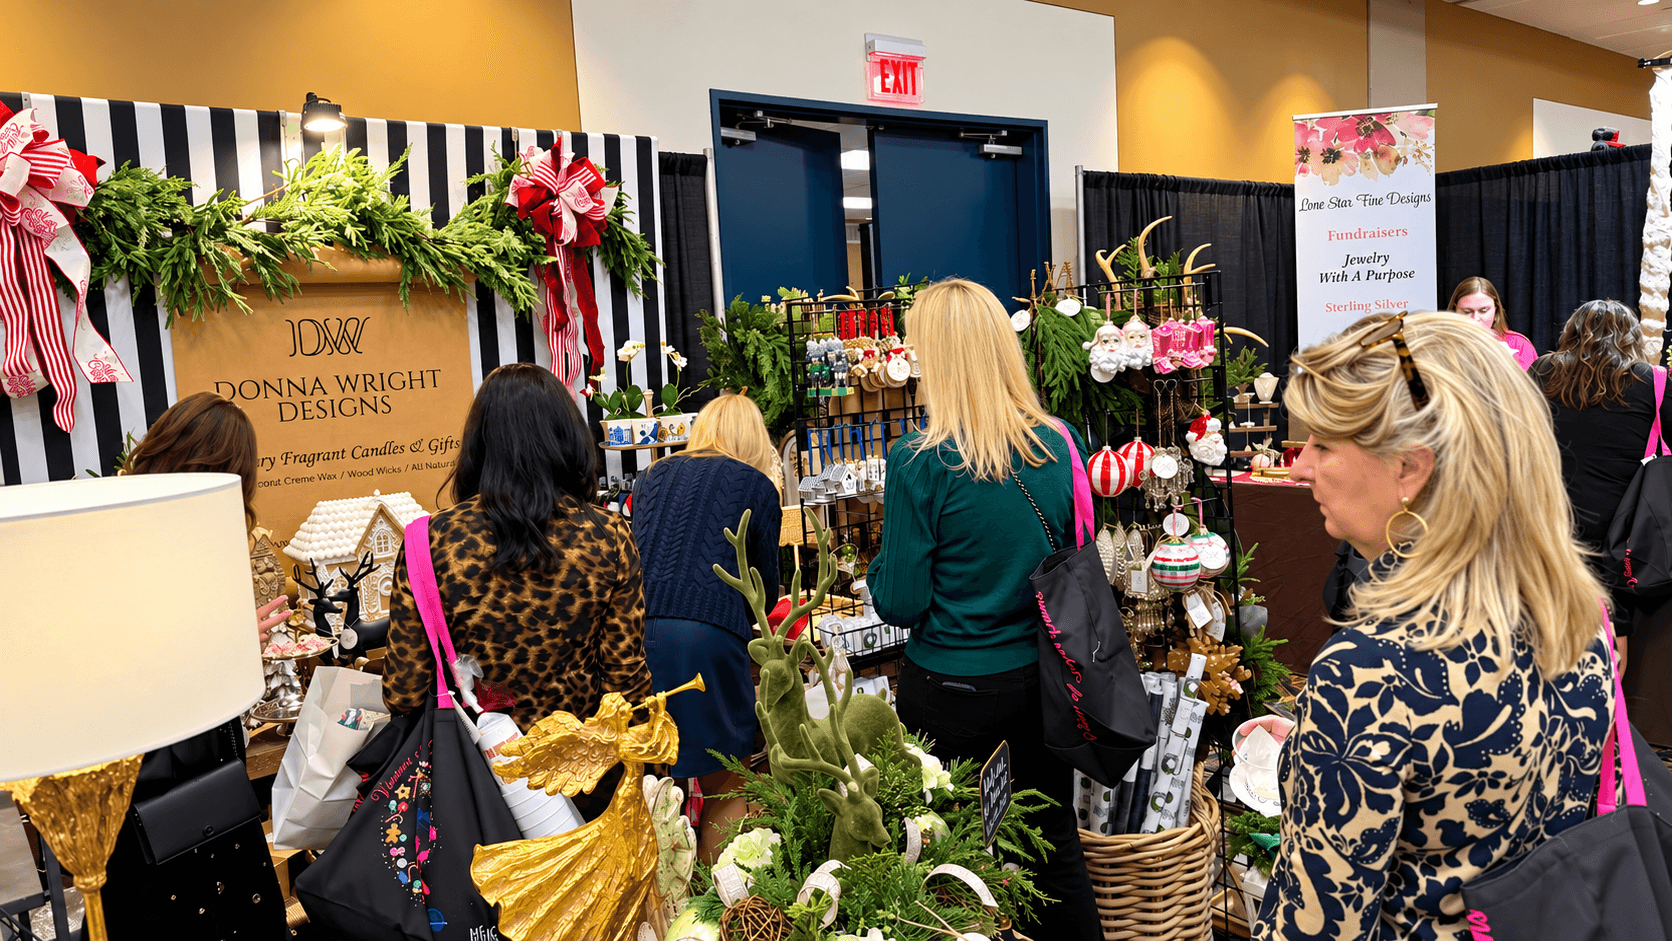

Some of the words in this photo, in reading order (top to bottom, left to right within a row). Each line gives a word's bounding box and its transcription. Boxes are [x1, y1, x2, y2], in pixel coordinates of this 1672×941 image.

[880, 59, 918, 96] EXIT
[1299, 198, 1325, 212] Lone
[1327, 196, 1353, 210] Star
[1356, 193, 1384, 207] Fine
[1386, 191, 1432, 208] Designs
[1328, 227, 1408, 241] Fundraisers
[1342, 252, 1390, 268] Jewelry
[1319, 271, 1348, 283] With
[1351, 270, 1361, 281] A
[1365, 269, 1415, 283] Purpose
[1325, 301, 1372, 314] Sterling
[1374, 299, 1409, 310] Silver
[213, 376, 328, 401] DONNA
[334, 369, 441, 393] WRIGHT
[277, 394, 392, 423] DESIGNS
[280, 448, 347, 468] Fragrant
[351, 441, 405, 460] Candles
[409, 438, 424, 453] &
[428, 435, 460, 456] Gifts
[283, 475, 315, 486] Creme
[317, 471, 337, 481] Wax
[347, 467, 374, 478] Wood
[376, 465, 402, 476] Wicks
[411, 462, 424, 472] All
[425, 460, 457, 471] Natura
